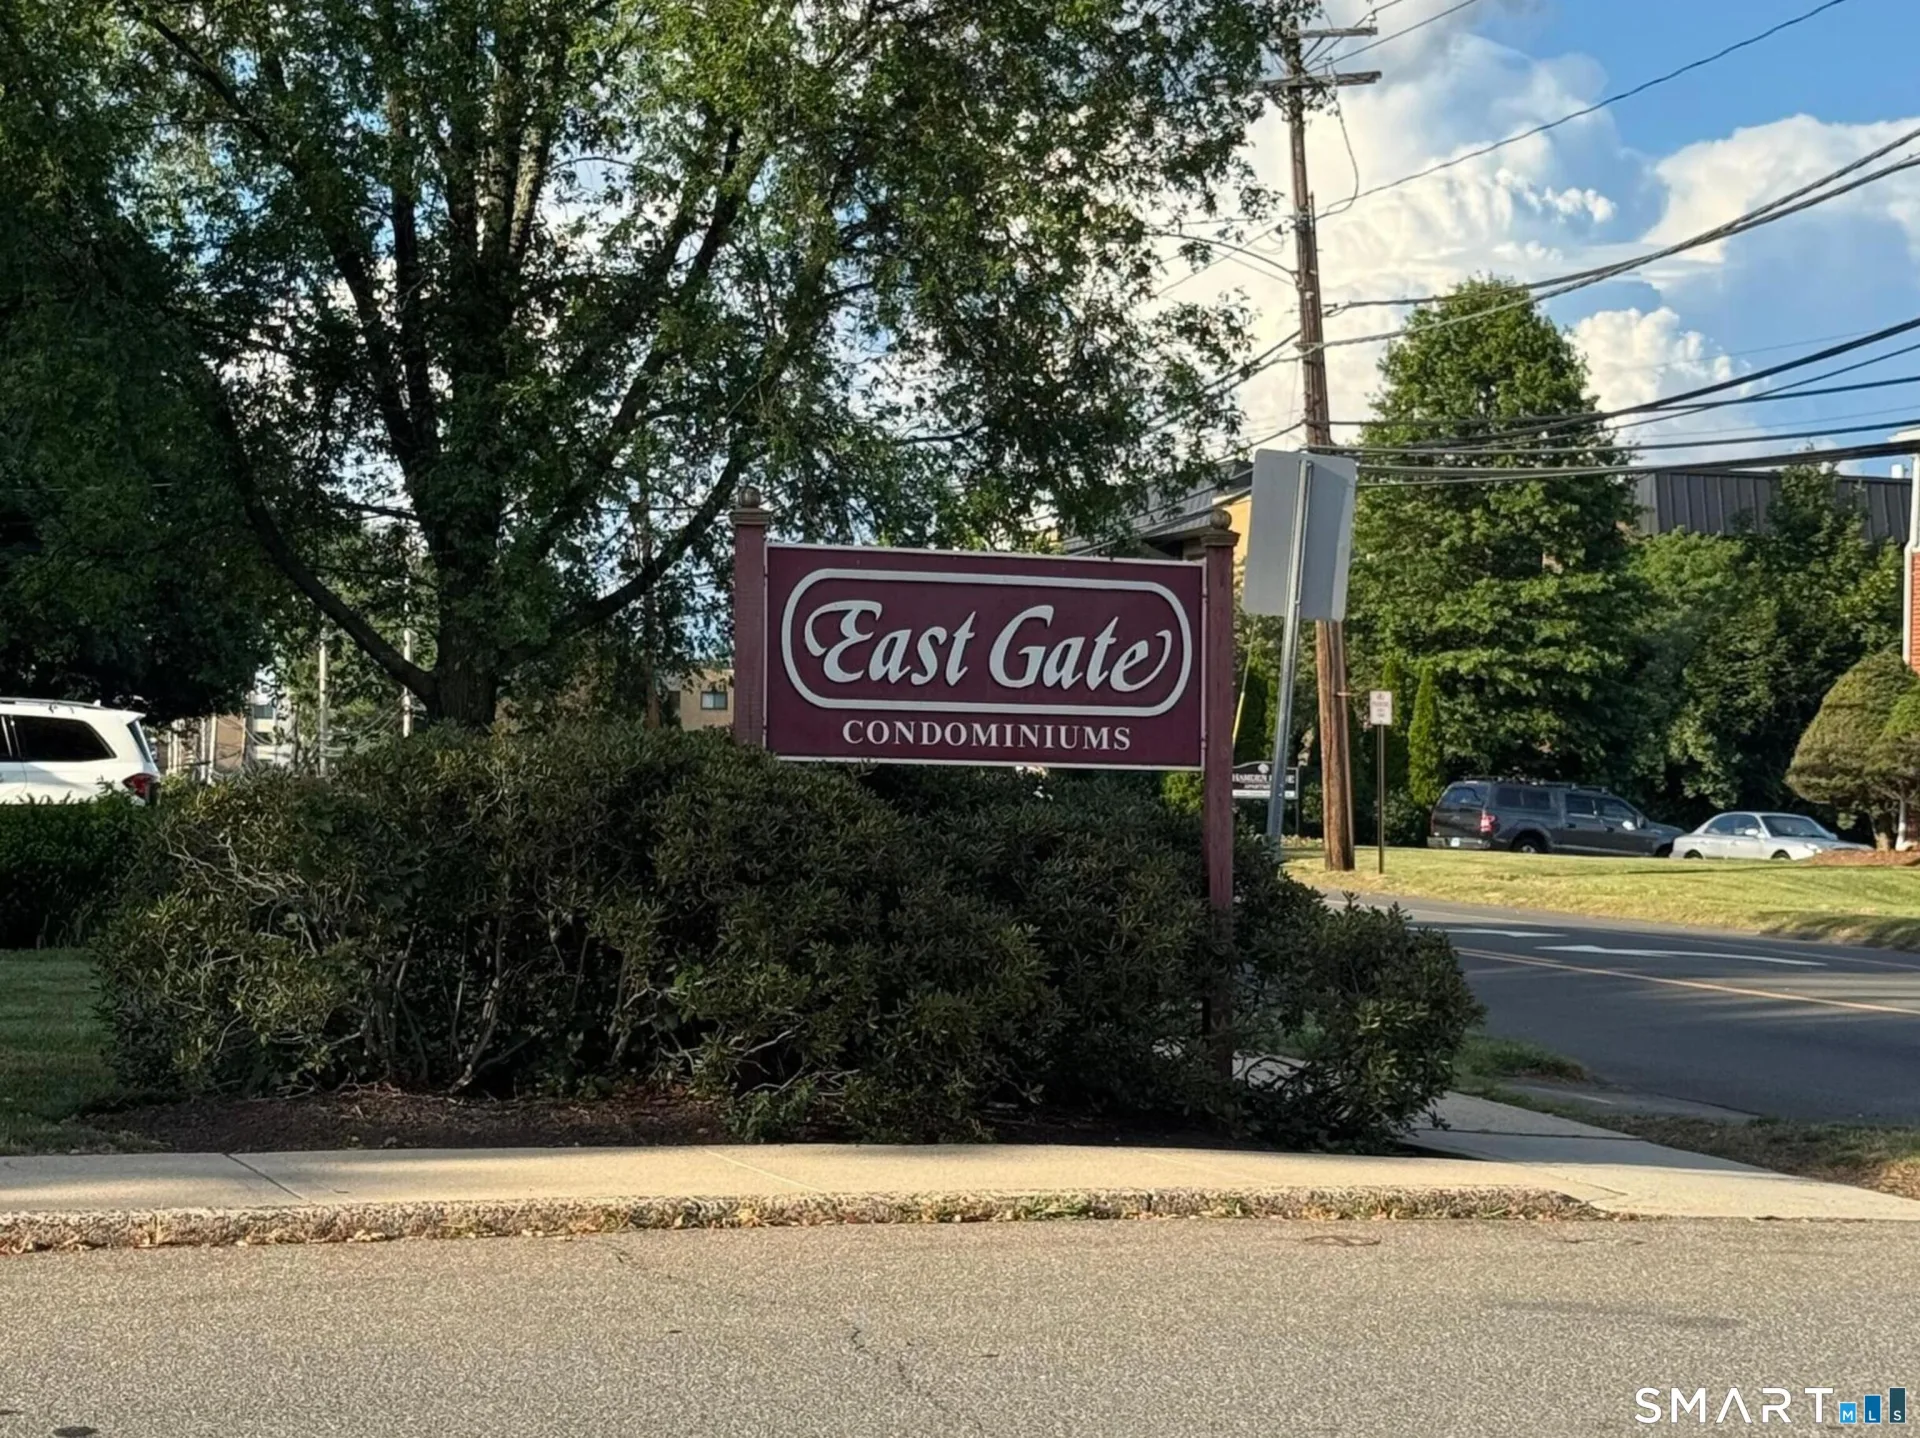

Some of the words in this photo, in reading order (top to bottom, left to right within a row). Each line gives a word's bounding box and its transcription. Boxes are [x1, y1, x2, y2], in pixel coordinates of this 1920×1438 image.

[804, 600, 976, 687] East
[989, 605, 1172, 692] Gate
[842, 719, 1131, 751] CONDOMINIUMS
